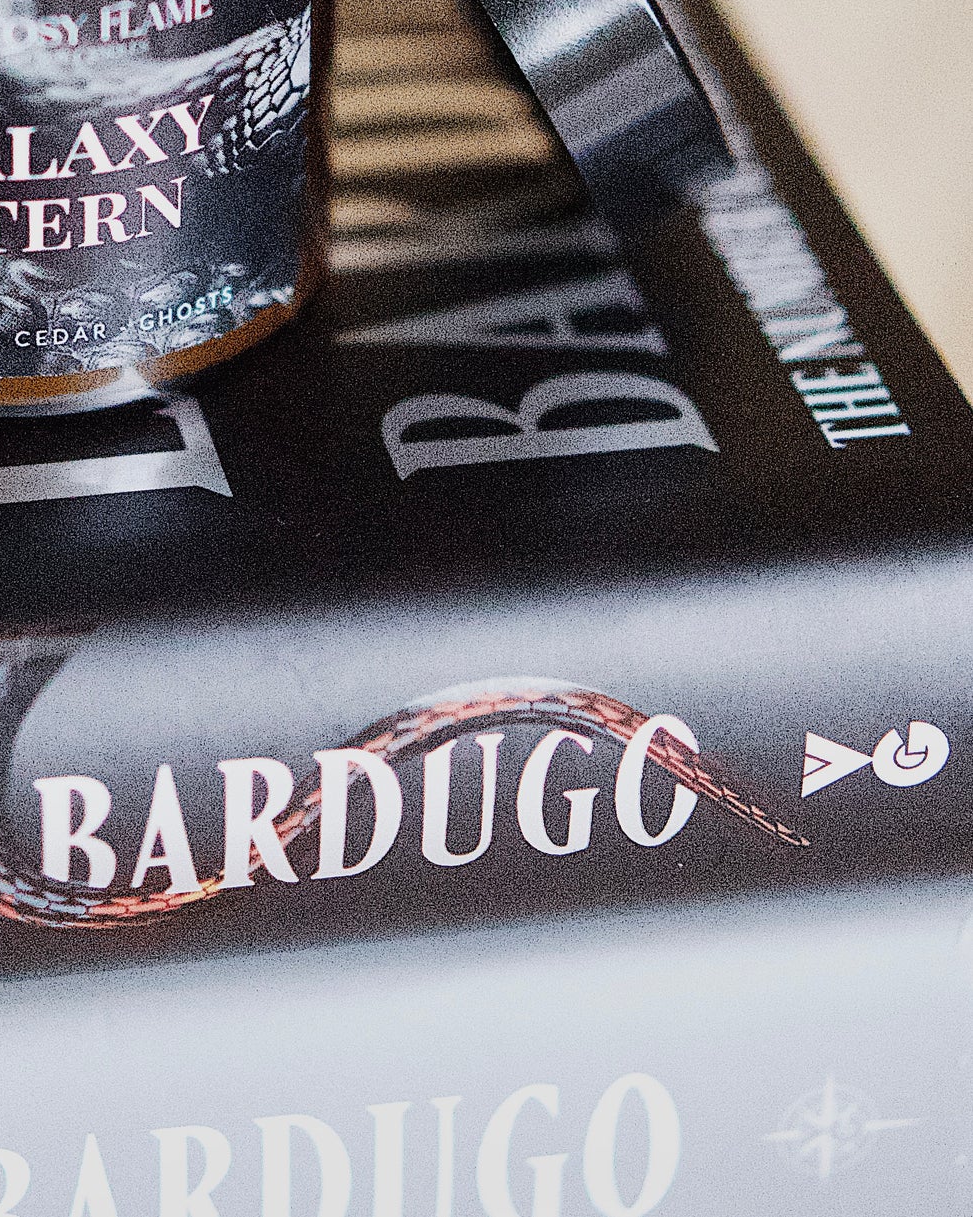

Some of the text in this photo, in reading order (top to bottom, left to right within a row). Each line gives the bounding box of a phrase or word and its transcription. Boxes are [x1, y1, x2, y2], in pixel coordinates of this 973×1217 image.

[14, 323, 107, 348] CEDAR
[139, 285, 234, 332] GHOSTS
[790, 362, 912, 449] THE
[32, 713, 701, 891] BARDUGO
